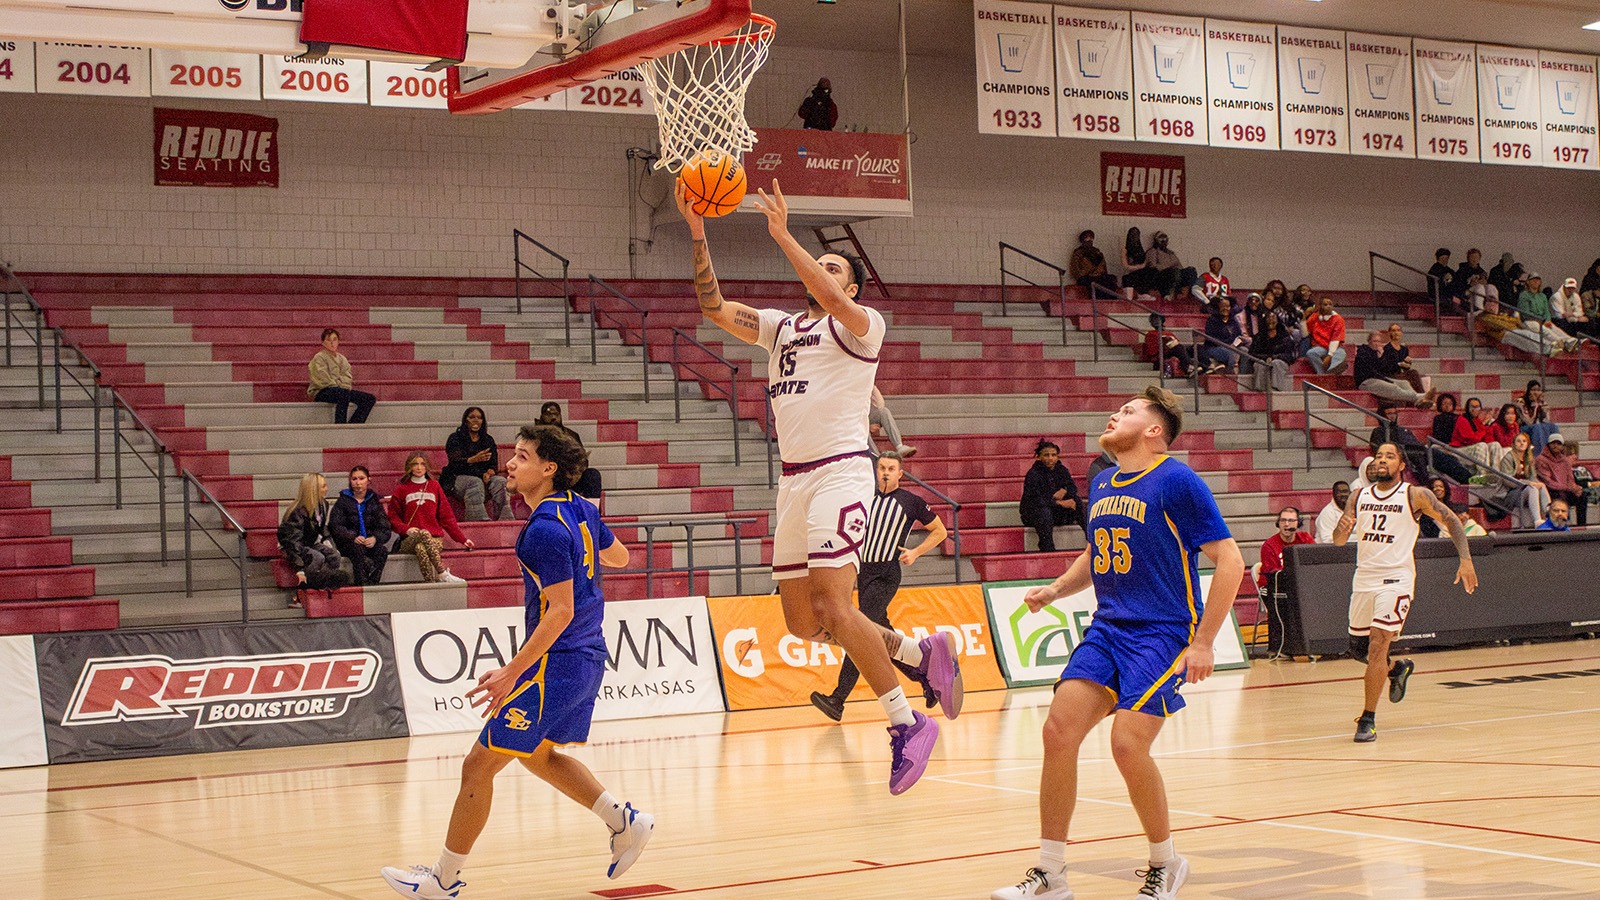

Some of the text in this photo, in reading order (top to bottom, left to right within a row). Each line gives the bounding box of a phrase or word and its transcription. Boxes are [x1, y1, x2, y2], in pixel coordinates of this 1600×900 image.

[978, 10, 1048, 24] BASKETBALL
[1209, 30, 1273, 44] BASKETBALL
[1281, 36, 1343, 50] BASKETBALL
[57, 61, 131, 85] 2004
[1541, 61, 1594, 73] BASKETBALL
[170, 64, 242, 89] 2005
[280, 69, 350, 93] 2006
[386, 76, 448, 98] 2006
[581, 85, 644, 107] 2024
[983, 82, 1050, 97] CHAMPIONS
[1063, 87, 1129, 101] CHAMPIONS
[1140, 92, 1203, 106] CHAMPIONS
[1213, 98, 1274, 112] CHAMPIONS
[1286, 103, 1344, 116] CHAMPIONS
[1354, 108, 1410, 121] CHAMPIONS
[992, 109, 1042, 129] 1933
[1072, 114, 1120, 134] 1958
[1149, 118, 1195, 138] 1968
[1421, 113, 1475, 126] CHAMPIONS
[1484, 118, 1538, 131] CHAMPIONS
[1222, 123, 1266, 143] 1969
[1294, 127, 1337, 147] 1973
[1546, 123, 1596, 135] CHAMPIONS
[160, 125, 273, 160] REDDIE
[1362, 132, 1404, 151] 1974
[1428, 137, 1468, 155] 1975
[1492, 142, 1532, 159] 1976
[1553, 146, 1589, 163] 1977
[161, 157, 271, 173] SEATING
[806, 151, 900, 177] MAKE IT YOURS
[1105, 165, 1182, 195] REDDIE
[1106, 190, 1181, 206] SEATING
[779, 351, 798, 377] 15
[770, 381, 809, 399] STATE
[1360, 503, 1403, 513] HENDERSON
[1372, 514, 1387, 531] 12
[1362, 533, 1395, 544] STATE
[1093, 527, 1132, 575] 35
[413, 615, 699, 684] OAWN
[778, 623, 986, 667] GAADE
[80, 658, 367, 714] REDDIE
[209, 698, 336, 722] BOOKSTORE
